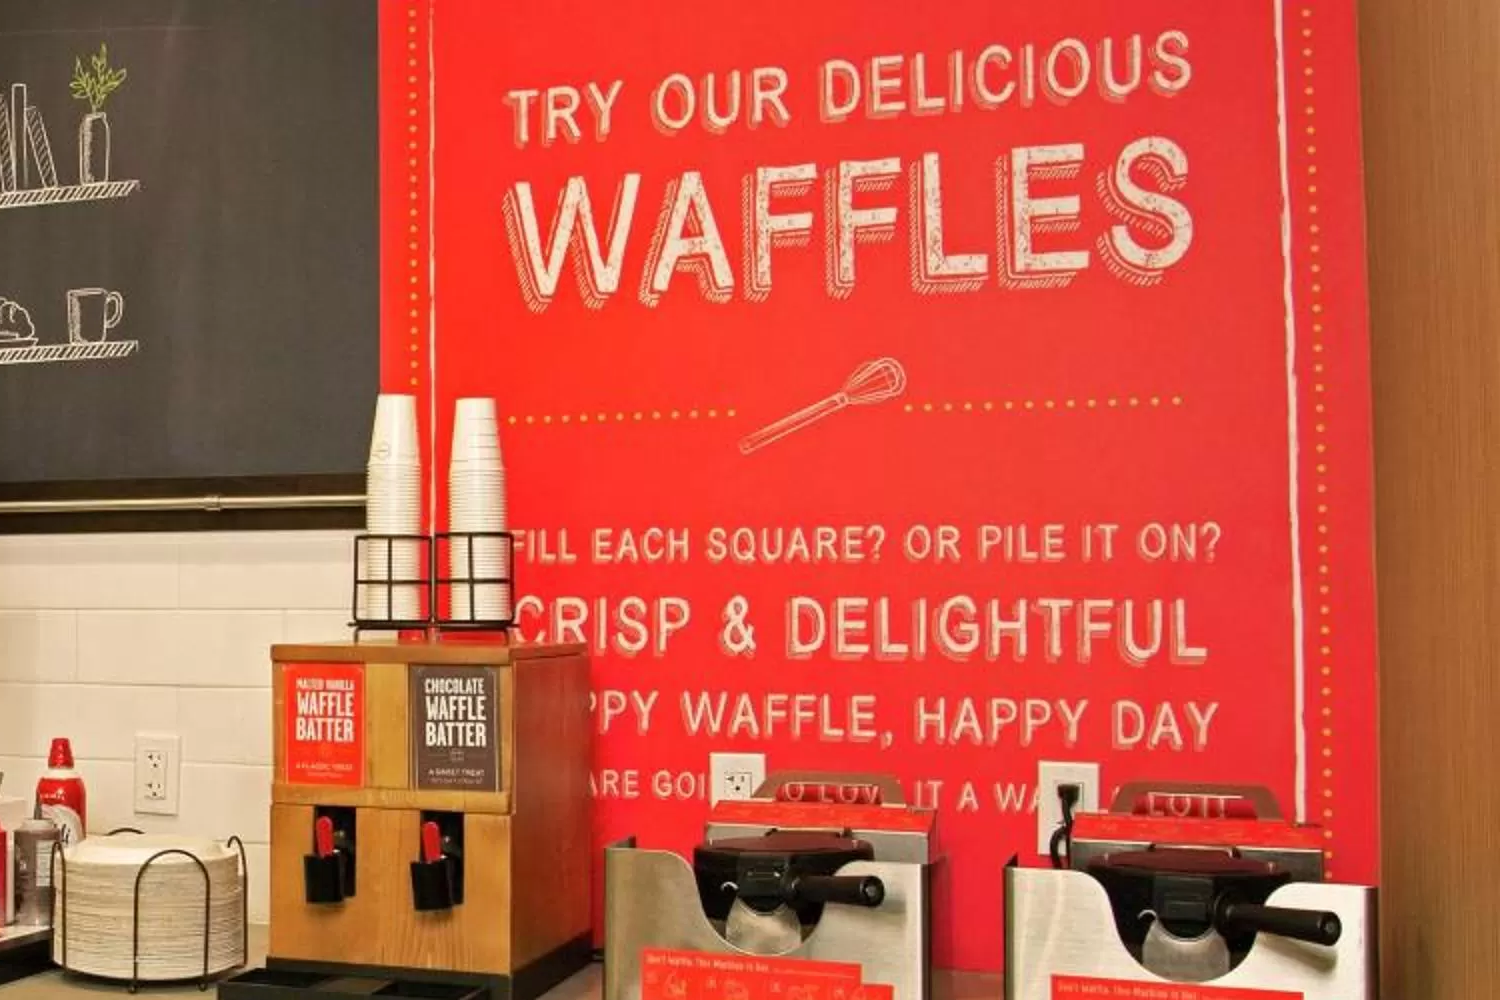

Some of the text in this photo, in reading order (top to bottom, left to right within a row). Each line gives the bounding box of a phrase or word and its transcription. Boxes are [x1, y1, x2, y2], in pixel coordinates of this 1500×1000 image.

[504, 30, 1192, 147] TRY OUR DELICIOUS
[503, 136, 1193, 313] WAFFLES
[592, 527, 689, 564] EACH
[707, 525, 885, 564] SQUARE?
[904, 525, 961, 563] OR
[978, 524, 1066, 563] PILE
[1082, 524, 1119, 561] IT
[1139, 521, 1221, 563] ON?
[513, 594, 1208, 667] CRISP & DELIGHTFUL
[297, 691, 355, 717] WAFFLE
[425, 678, 485, 695] CHOCOLATE
[296, 717, 354, 742] BATTER
[426, 696, 487, 721] WAFFLE
[680, 690, 893, 747] WAFFLE,
[914, 697, 1088, 746] HAPPY
[1112, 699, 1218, 751] DAY
[425, 722, 487, 747] BATTER
[651, 768, 706, 800] GOI
[914, 779, 943, 809] IT
[956, 780, 980, 812] A
